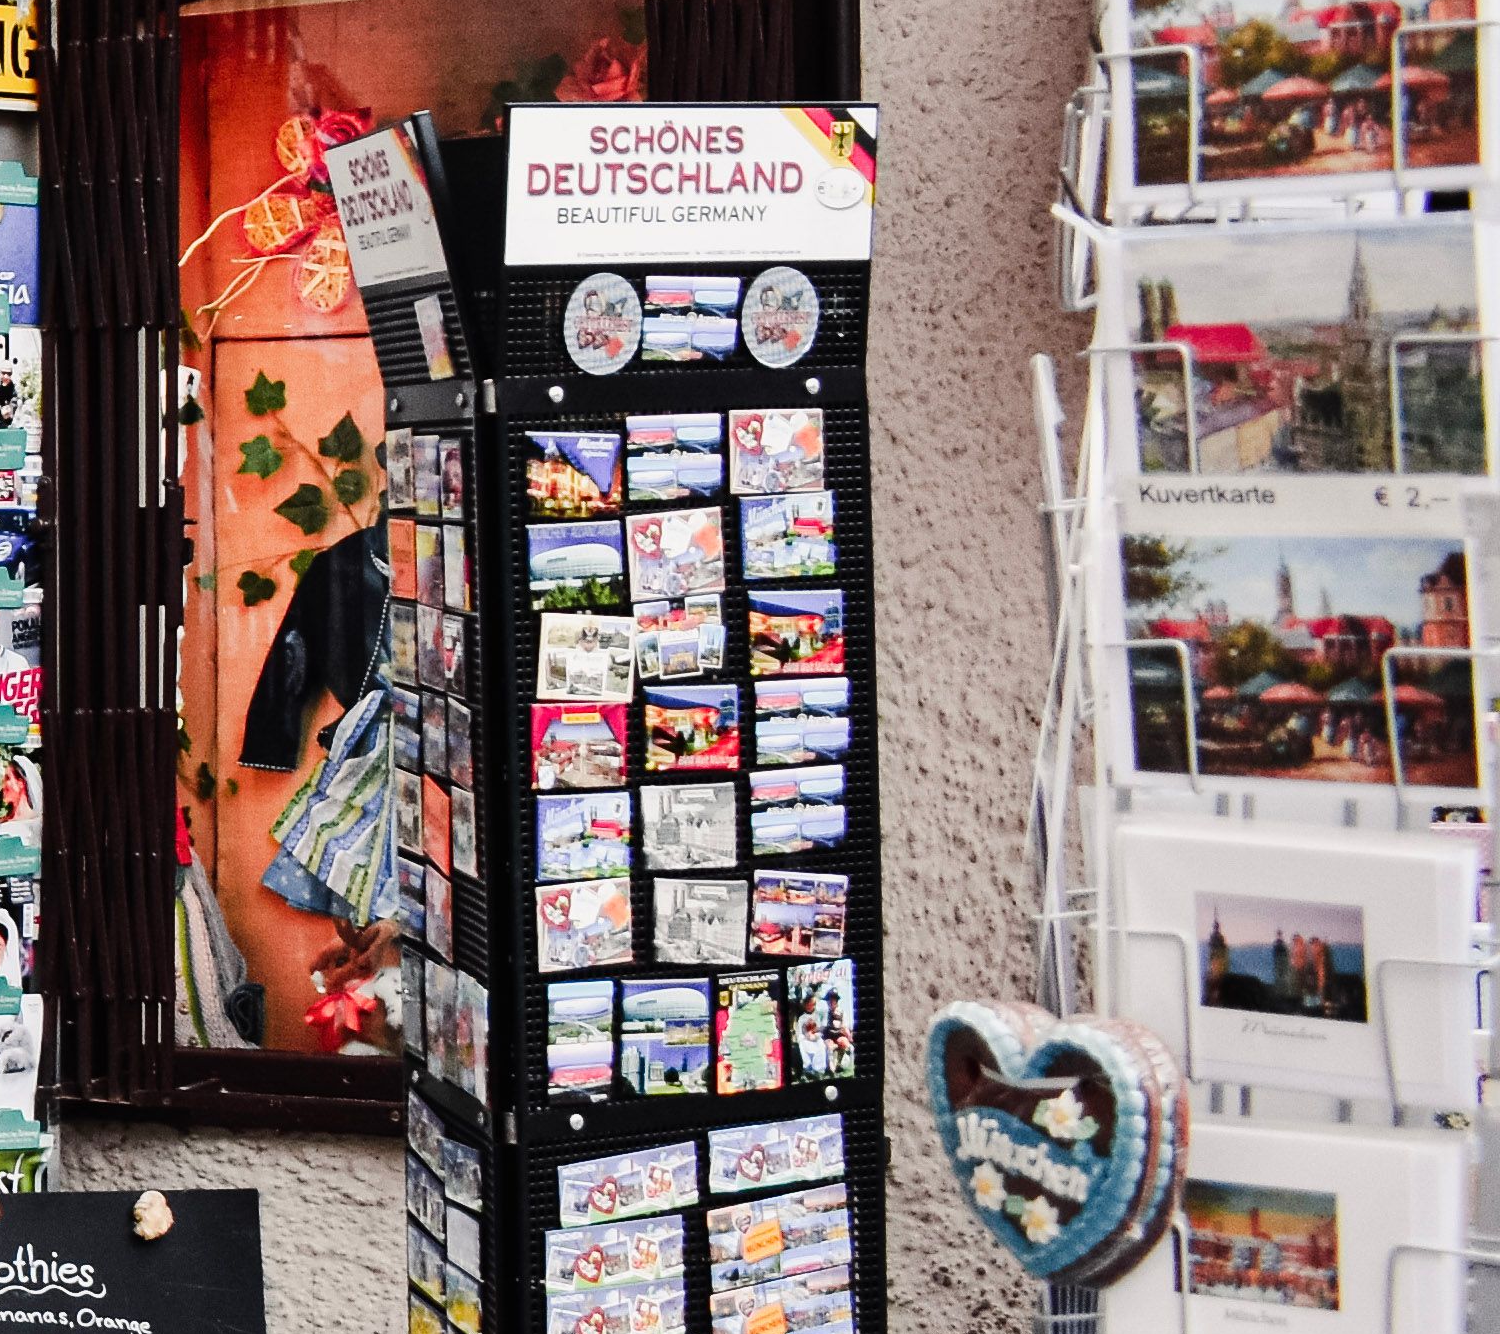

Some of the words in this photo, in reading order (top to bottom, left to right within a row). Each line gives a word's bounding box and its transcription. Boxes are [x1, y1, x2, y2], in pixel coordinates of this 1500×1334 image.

[589, 120, 744, 155] SCHÖNES
[526, 162, 803, 196] DEUTSCHLAND
[556, 205, 668, 226] BEAUTIFUL
[671, 204, 767, 223] GERMANY
[1139, 483, 1276, 508] Kuvertkarte
